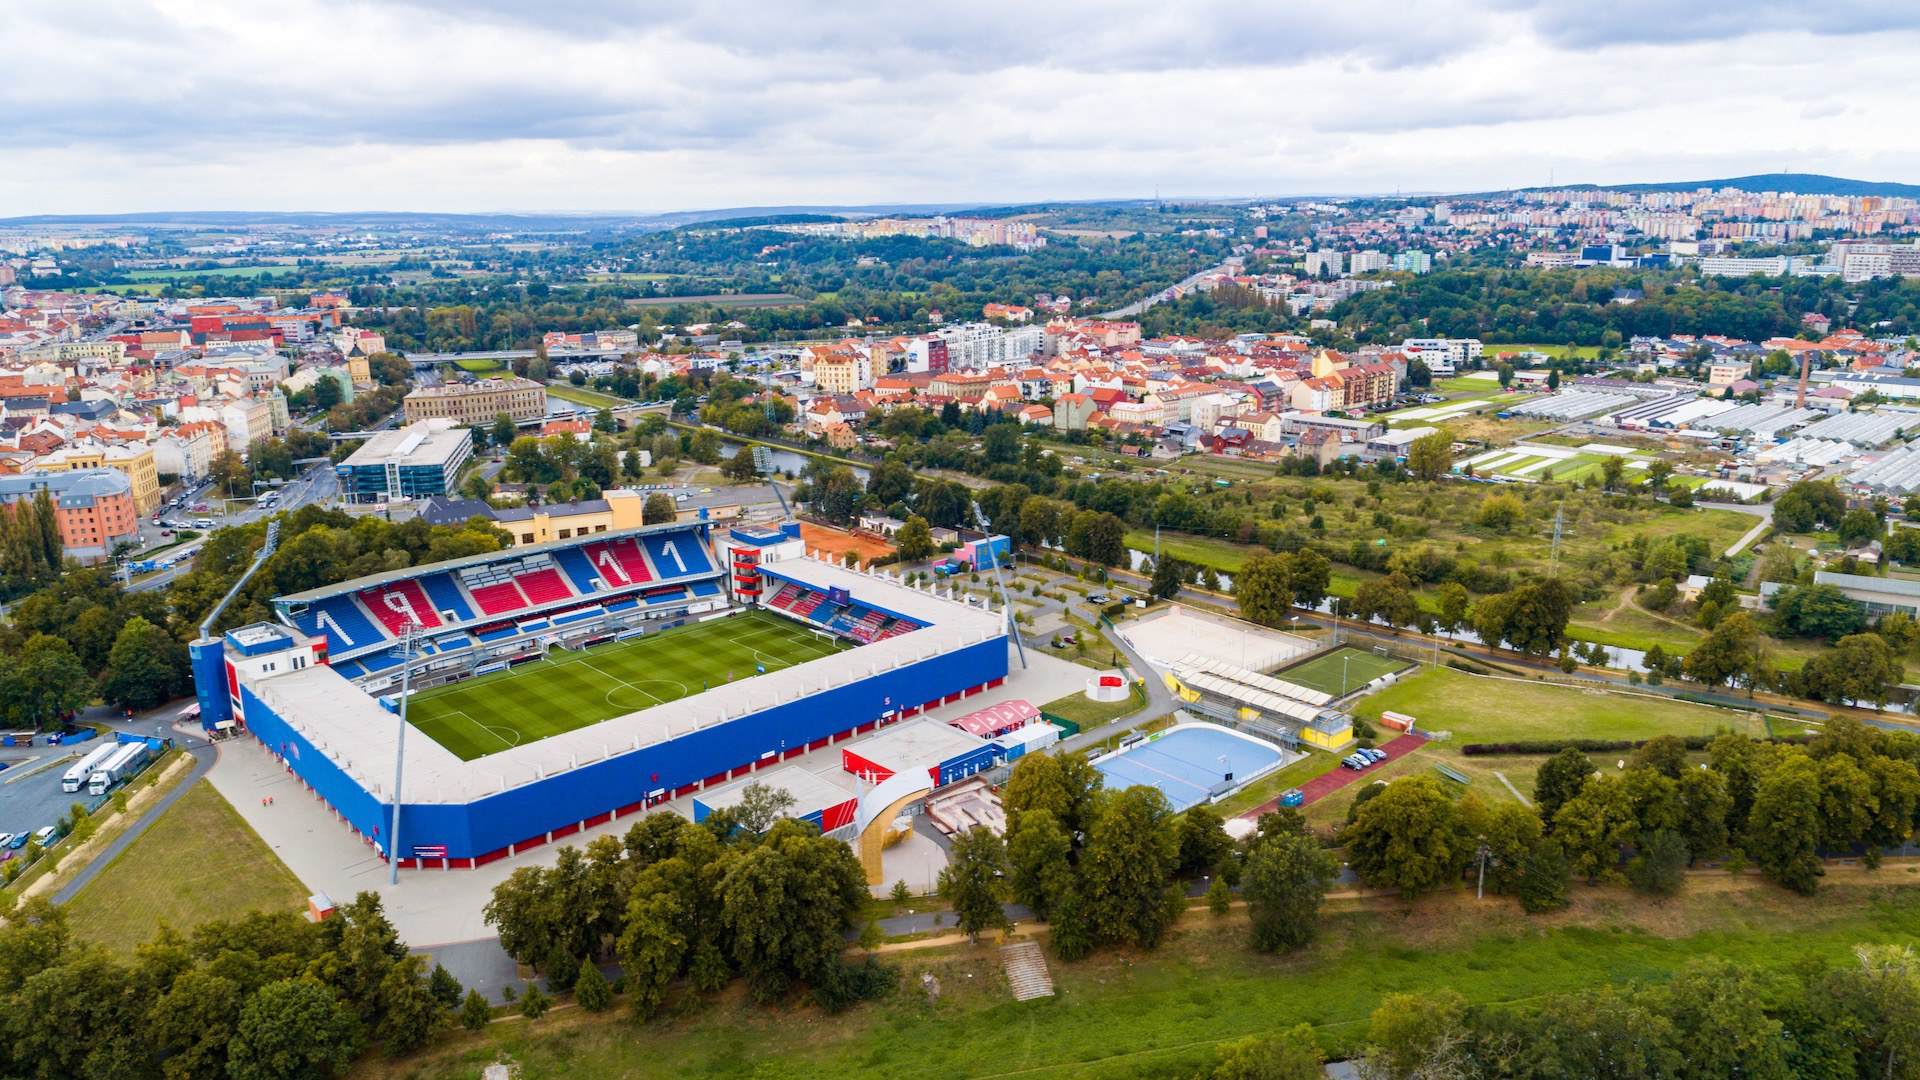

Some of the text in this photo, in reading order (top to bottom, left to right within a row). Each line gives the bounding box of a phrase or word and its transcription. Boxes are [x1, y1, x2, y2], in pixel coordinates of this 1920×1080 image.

[316, 540, 688, 646] 1 9 1 1
